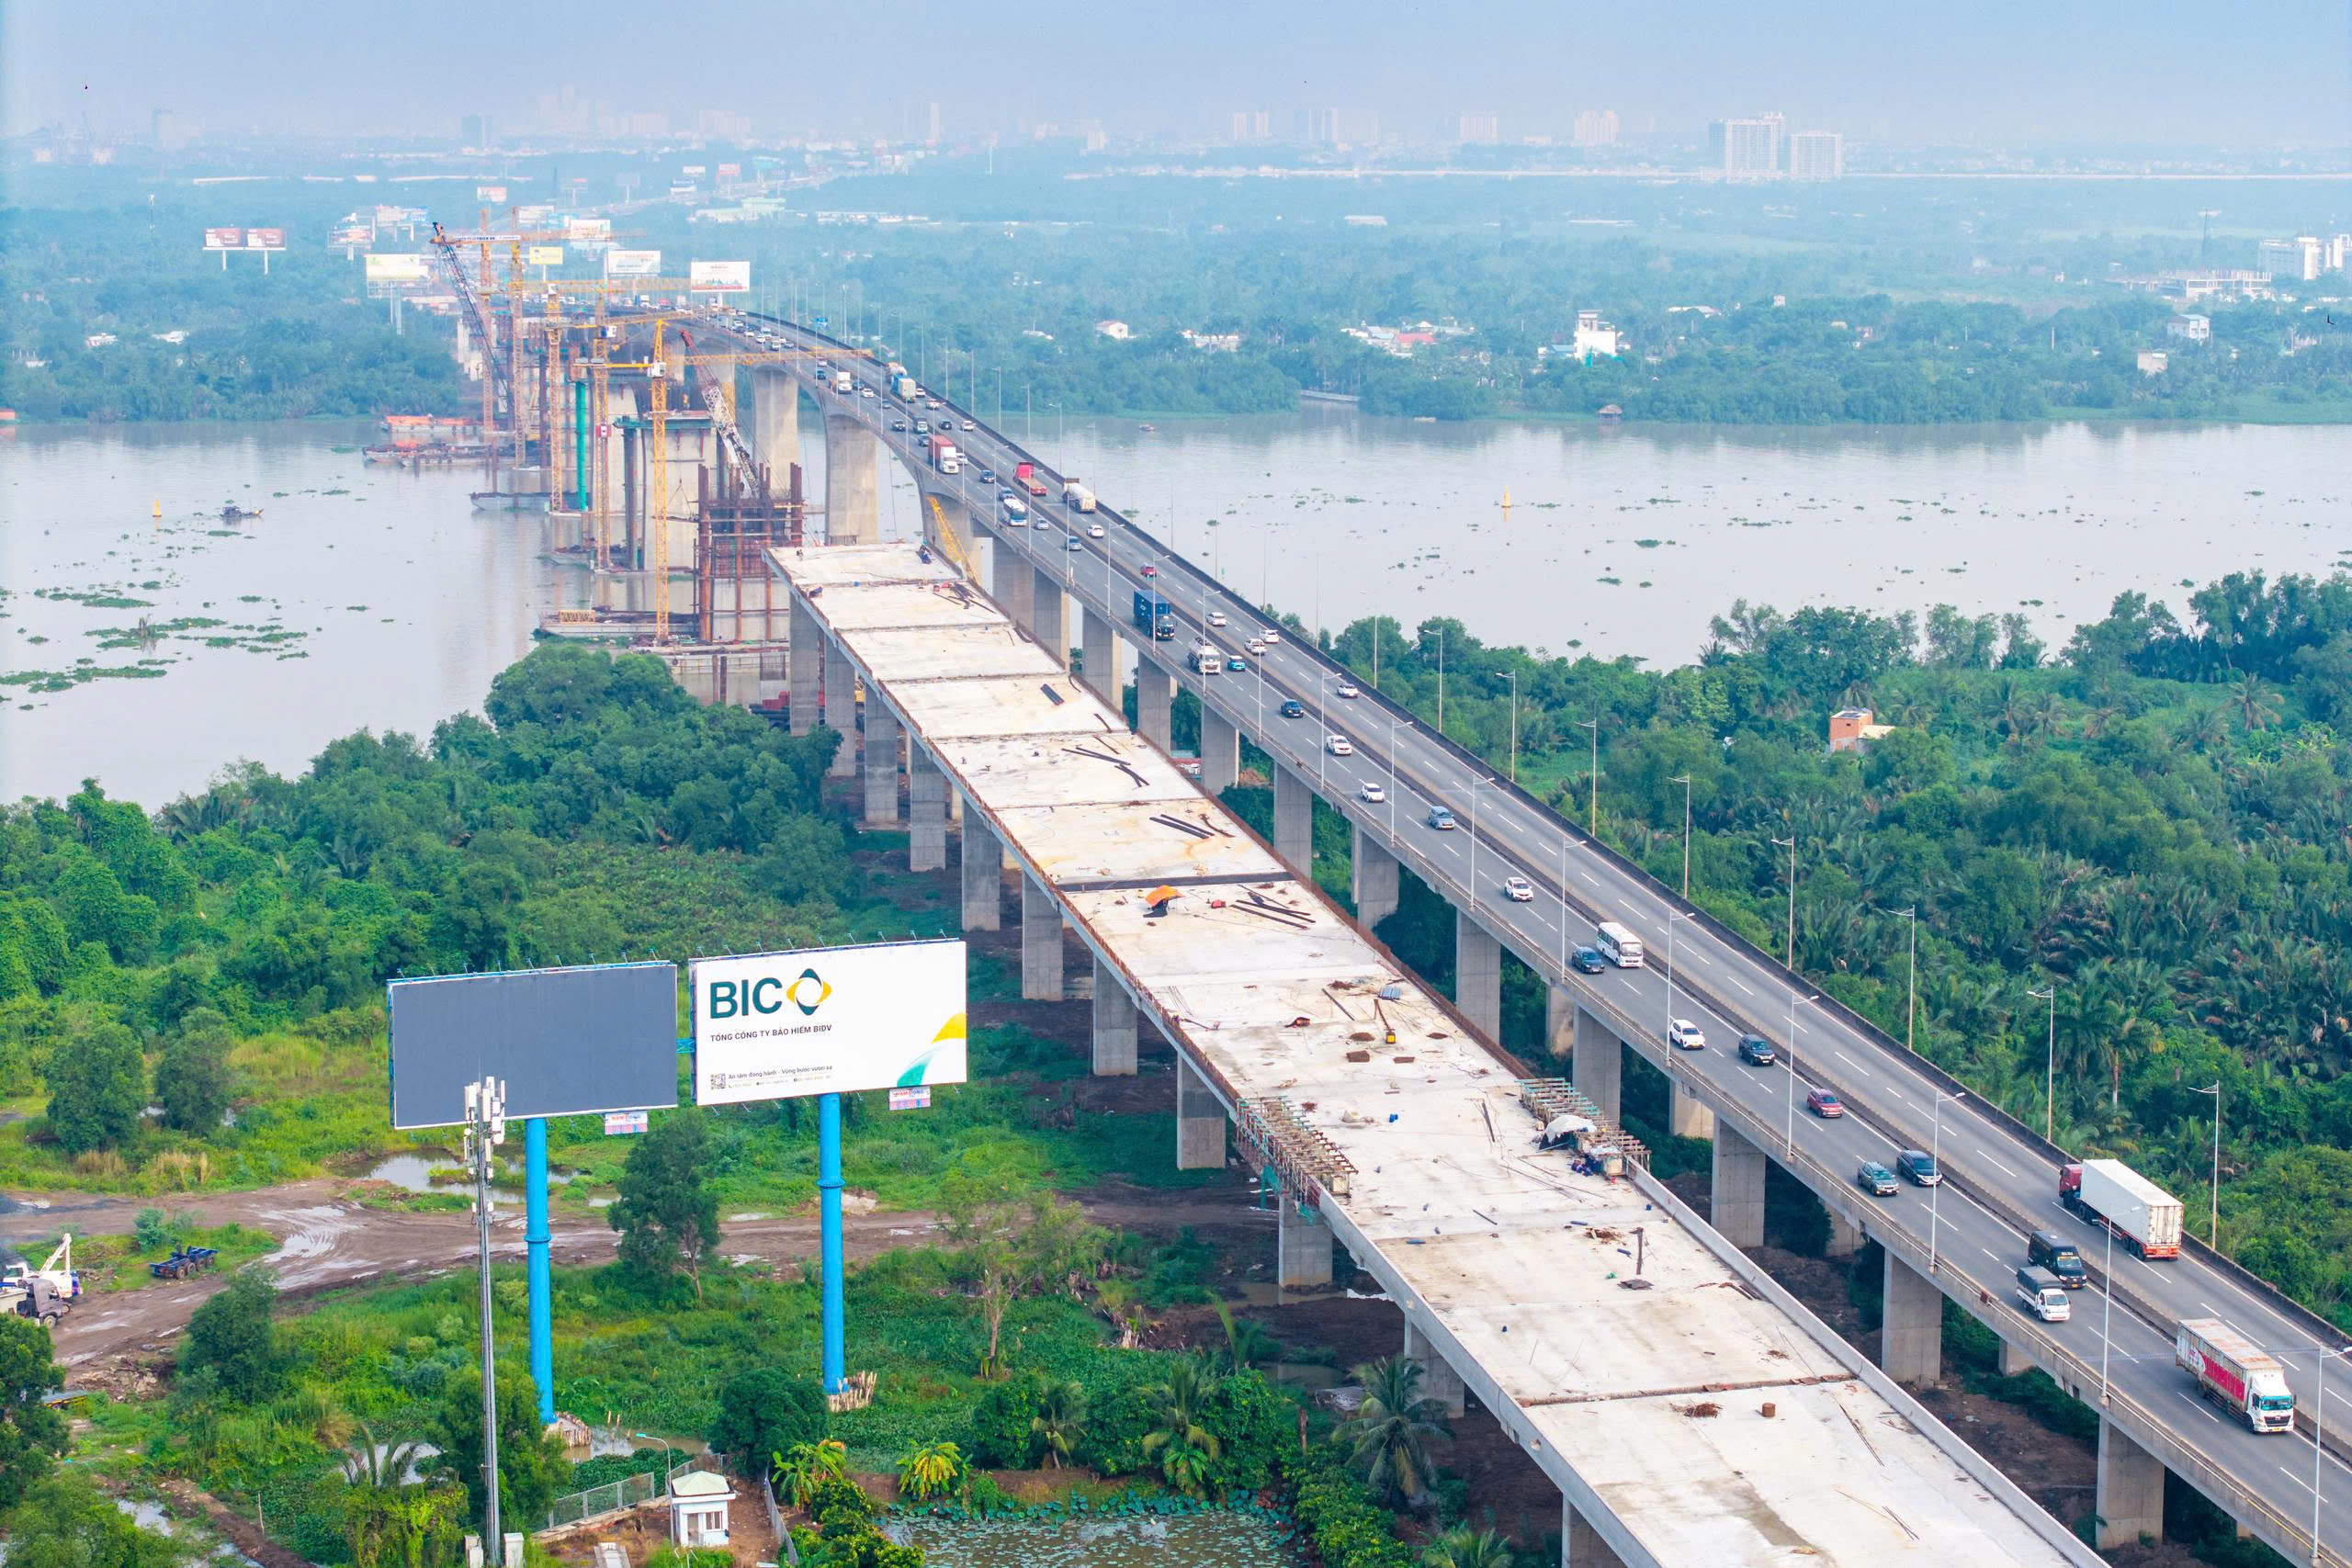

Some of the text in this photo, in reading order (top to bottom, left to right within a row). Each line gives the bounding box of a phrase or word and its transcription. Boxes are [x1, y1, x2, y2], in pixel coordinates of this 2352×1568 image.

[710, 977, 783, 1019] BIC
[734, 1030, 758, 1040] CÔNG
[772, 1026, 789, 1036] BẢO
[813, 1024, 832, 1032] BIDV
